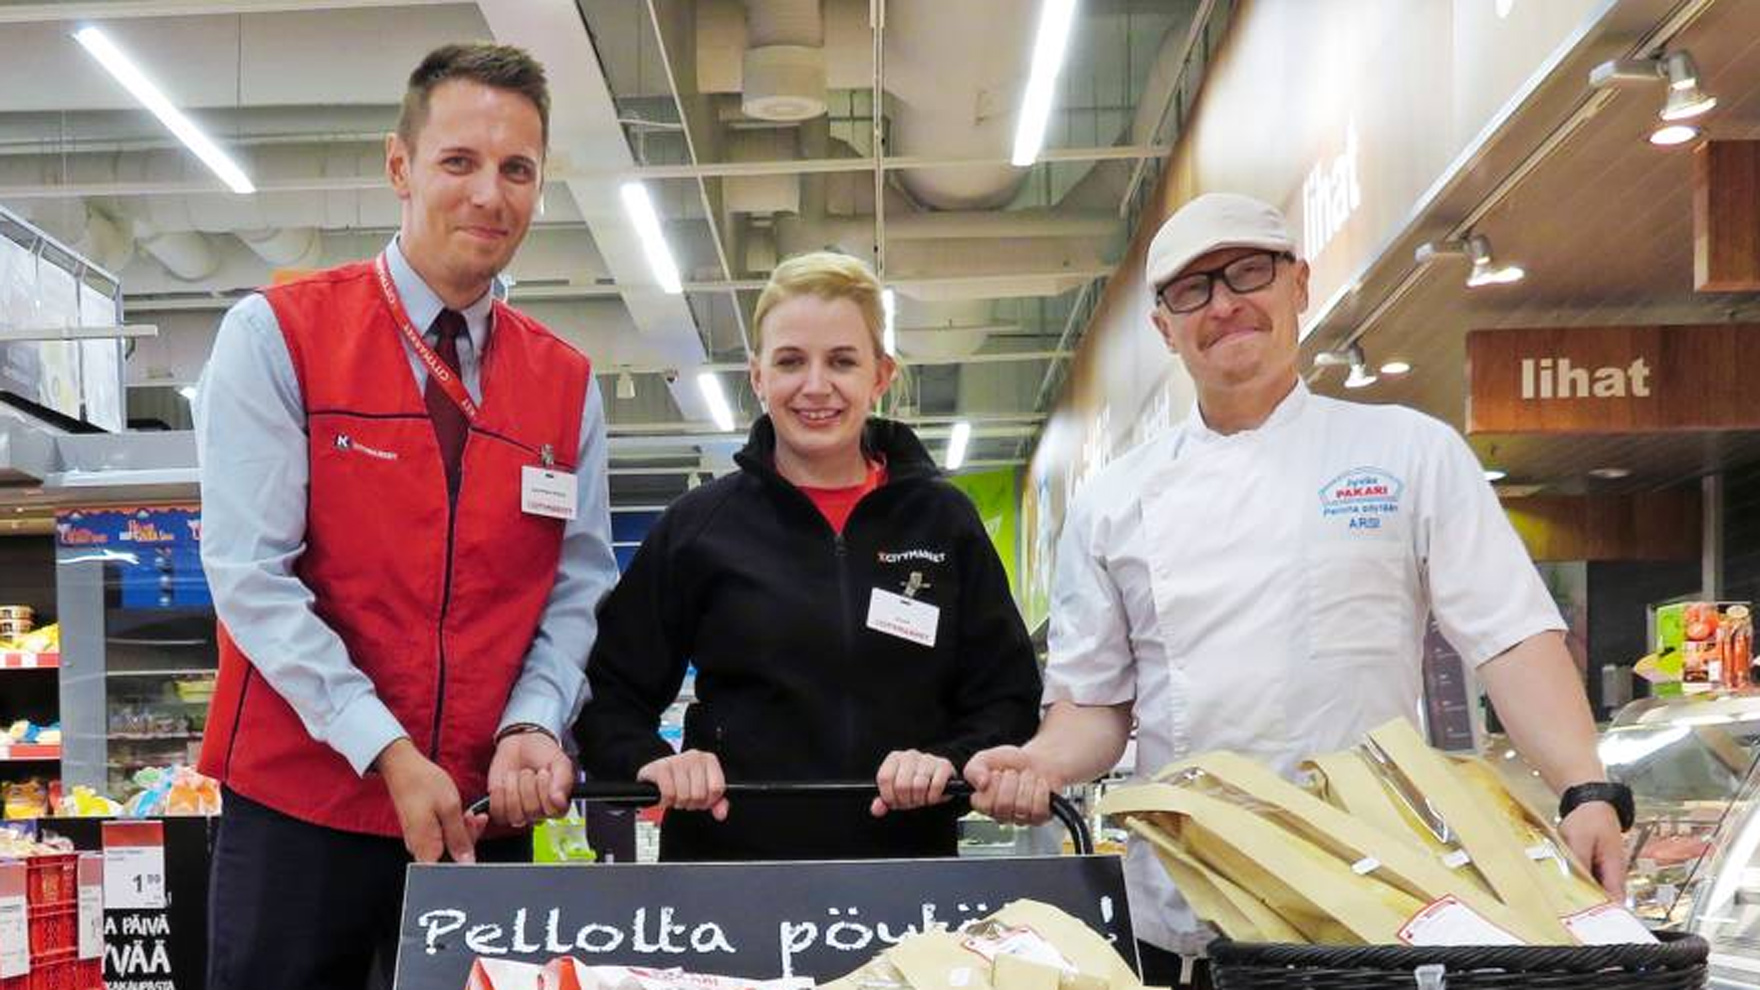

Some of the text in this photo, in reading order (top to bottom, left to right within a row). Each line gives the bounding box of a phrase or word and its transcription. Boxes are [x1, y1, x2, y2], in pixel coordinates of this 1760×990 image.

[1302, 116, 1360, 262] lihat
[402, 322, 451, 382] CITYMARKET
[1520, 357, 1650, 399] lihat
[1336, 486, 1388, 499] PAKARI
[122, 913, 171, 937] PÄIVÄ
[418, 907, 736, 955] Pellolta
